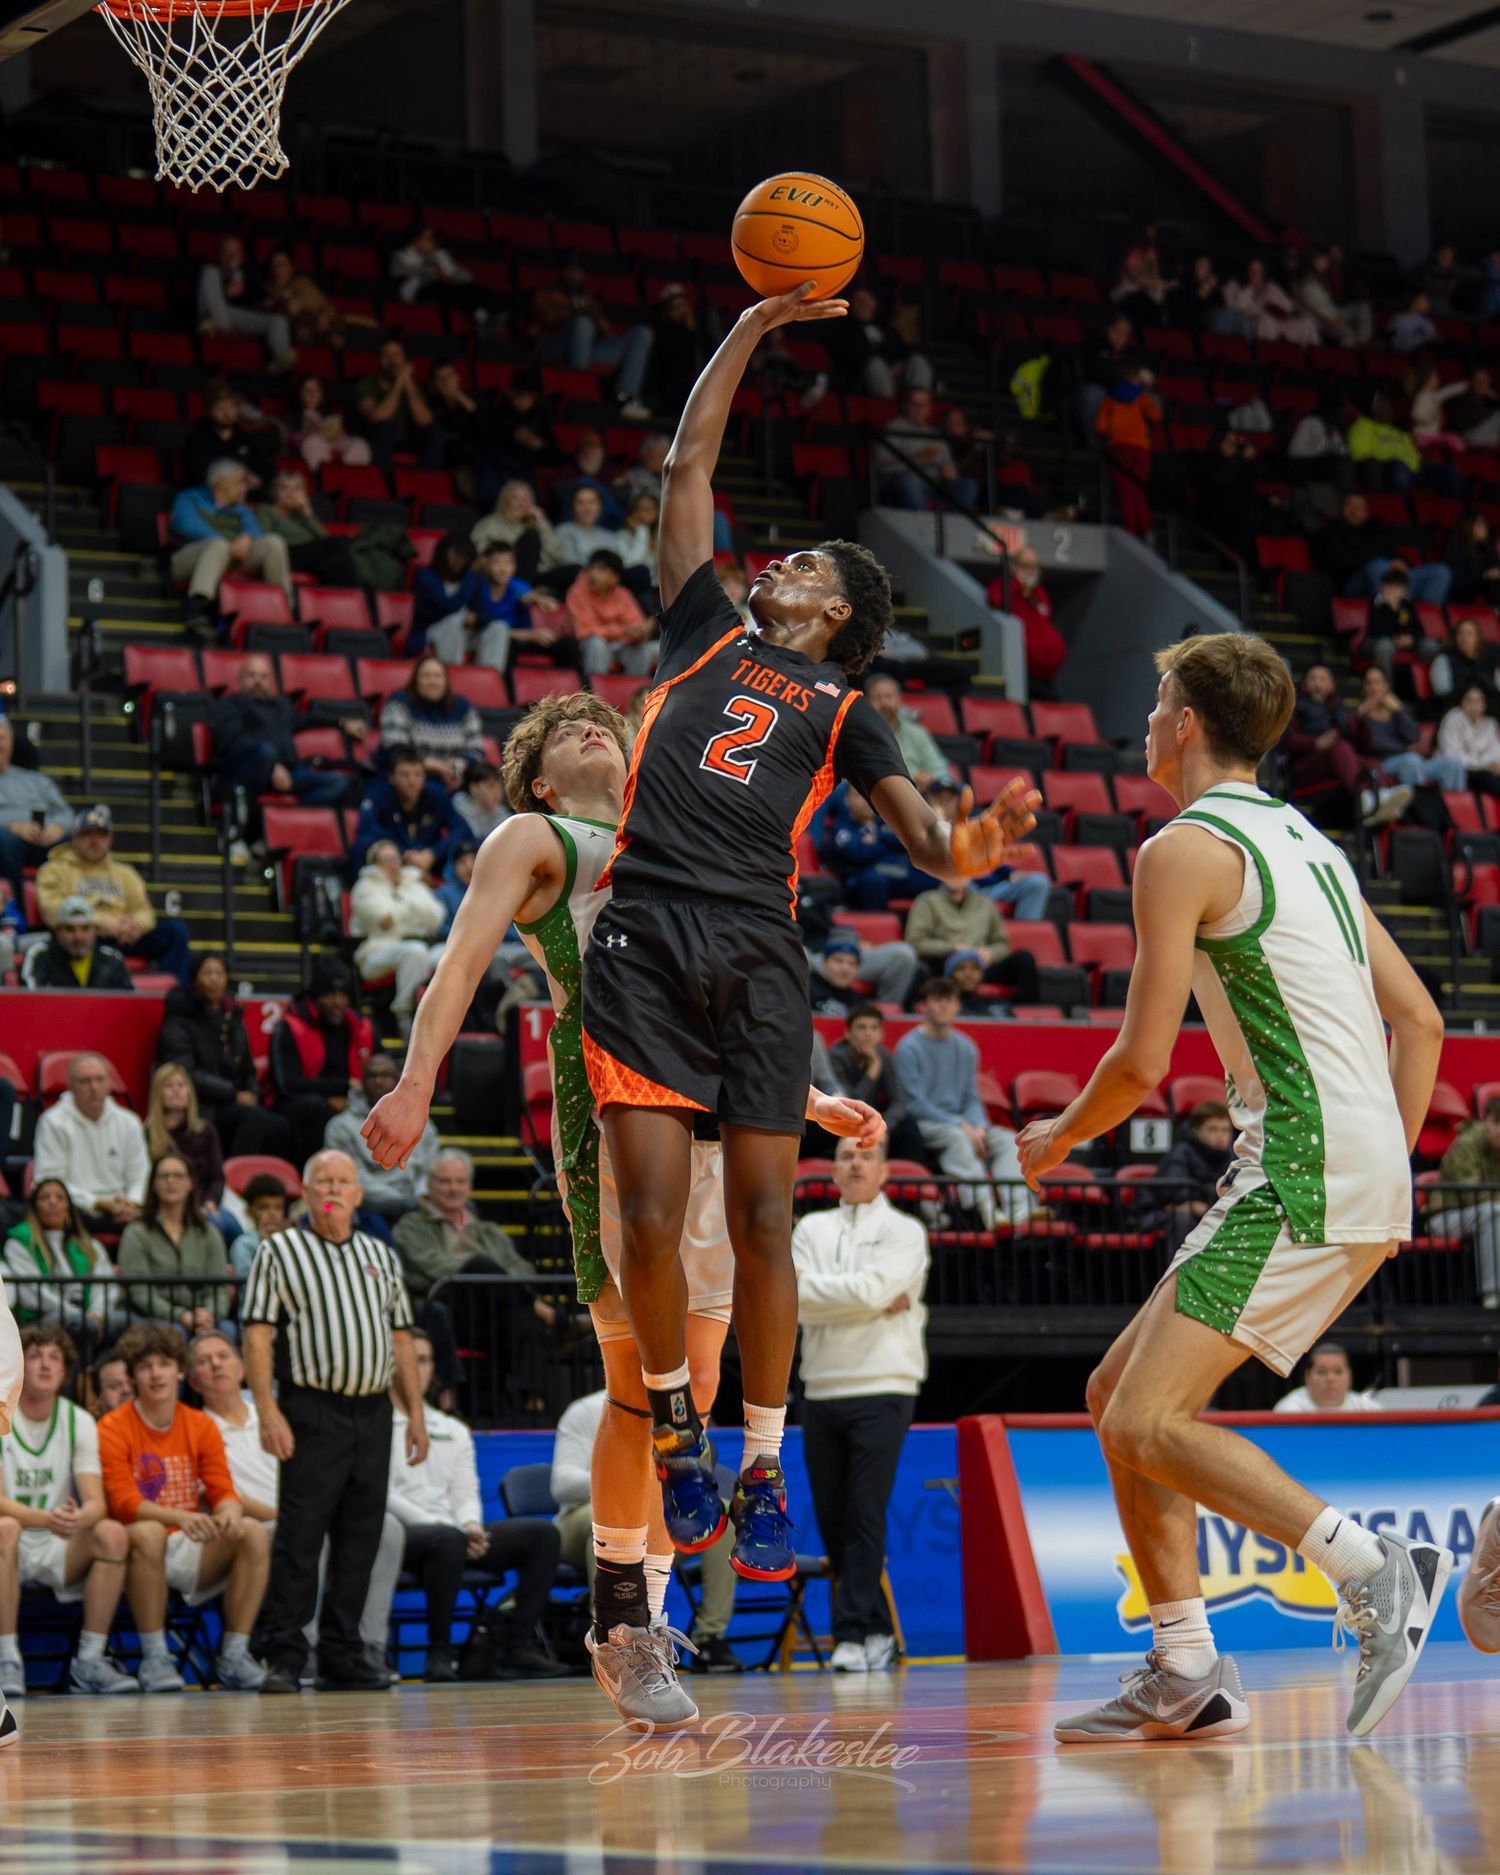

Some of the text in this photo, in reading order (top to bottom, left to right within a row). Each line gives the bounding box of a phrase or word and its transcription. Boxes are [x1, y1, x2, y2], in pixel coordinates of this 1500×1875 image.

[768, 186, 825, 207] EVO
[1053, 527, 1072, 563] 2
[730, 658, 816, 712] TIGERS
[699, 695, 778, 785] 2
[1305, 861, 1365, 966] 11
[260, 1001, 283, 1035] 2
[525, 1009, 541, 1040] 1
[1196, 1508, 1478, 1577] YSSAA
